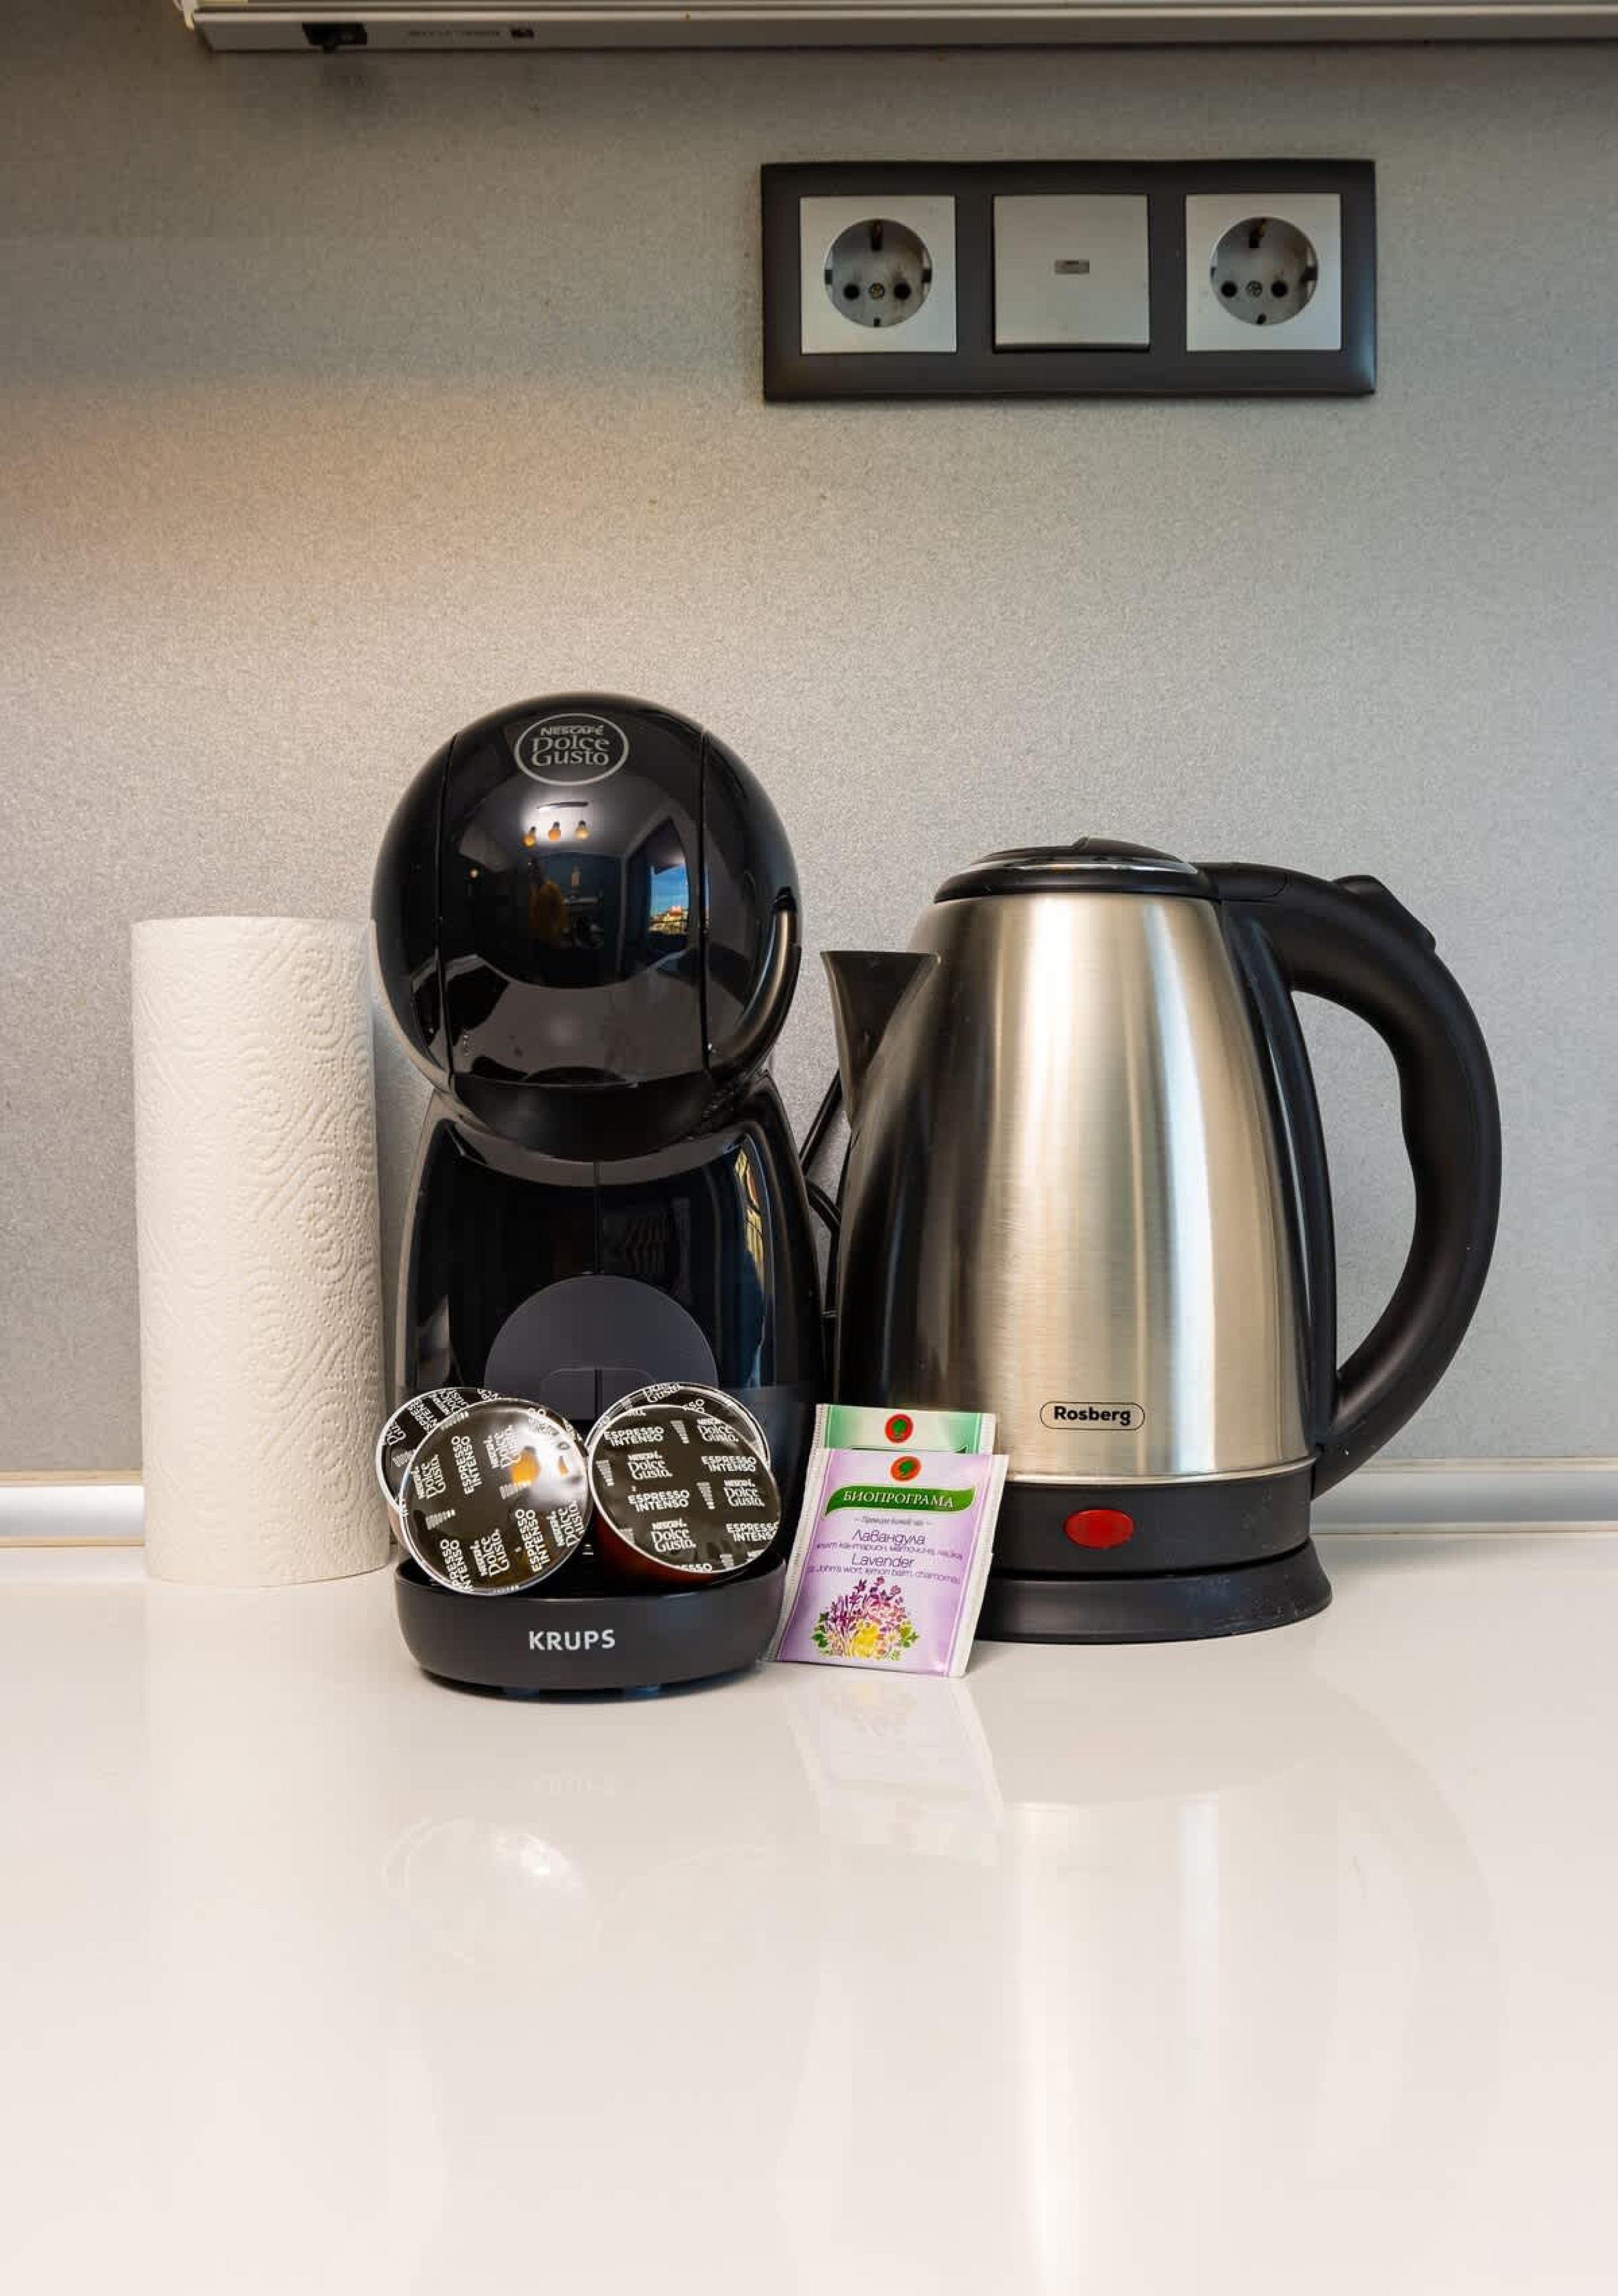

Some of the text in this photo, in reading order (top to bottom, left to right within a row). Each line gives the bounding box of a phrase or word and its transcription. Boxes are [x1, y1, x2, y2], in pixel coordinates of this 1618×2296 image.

[532, 734, 610, 752] Dolce
[532, 749, 609, 767] Gusto
[1054, 1406, 1131, 1426] Rosberg
[604, 1427, 664, 1440] ESPRESSO
[451, 1436, 474, 1495] ESPRESSO
[461, 1436, 483, 1486] INTENSO
[701, 1455, 756, 1465] ESPRESSO
[709, 1464, 756, 1473] INTENSO
[628, 1489, 690, 1505] ESPRESSO
[635, 1499, 689, 1513] INTENSO
[843, 1490, 954, 1508] БИОПРОГРАМА
[515, 1509, 542, 1572] ESPRESSO
[526, 1510, 551, 1564] INTENSO
[851, 1528, 926, 1545] Лавандула
[851, 1553, 915, 1568] Lavender
[529, 1629, 616, 1651] KRUPS
